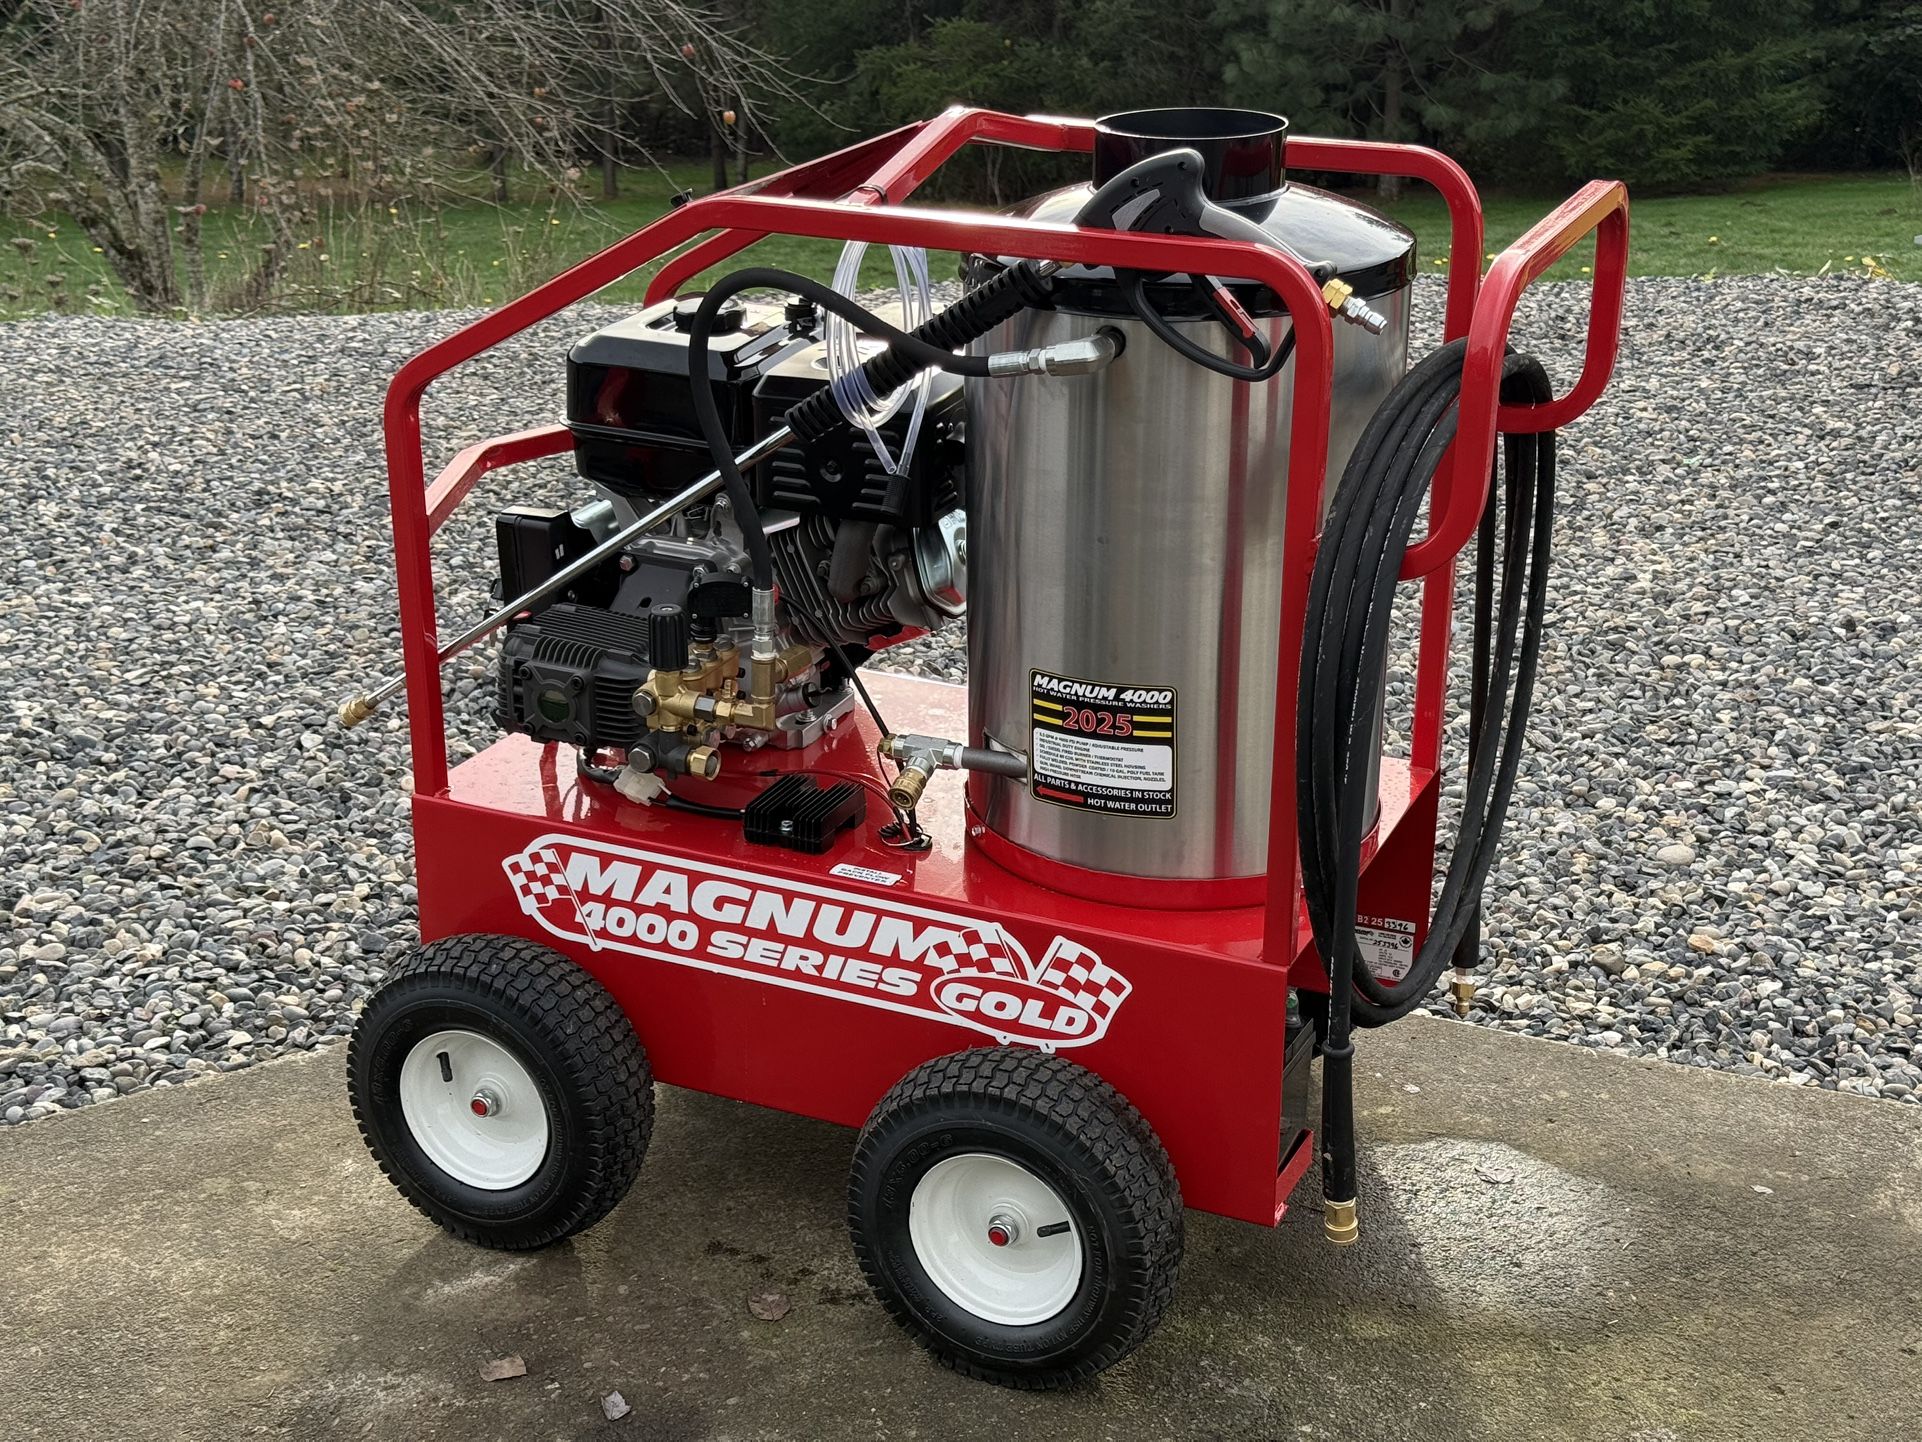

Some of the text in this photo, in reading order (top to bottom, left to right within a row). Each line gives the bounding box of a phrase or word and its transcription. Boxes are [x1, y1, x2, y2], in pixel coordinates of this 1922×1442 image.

[1033, 686, 1050, 694] HOT
[1050, 690, 1077, 700] WATER
[1079, 698, 1124, 707] PRESSURE
[1034, 674, 1172, 704] MAGNUM 4000
[1062, 706, 1132, 736] 2025
[1092, 743, 1120, 751] ADJUSTABLE
[1034, 773, 1046, 783] ALL
[1047, 777, 1069, 788] PARTS
[1078, 784, 1131, 798] ACCESSORIES
[1087, 798, 1172, 812] HOT WATER OUTLET
[562, 851, 955, 968] MAGNUM
[1357, 914, 1368, 924] B2
[1371, 917, 1383, 927] 25
[574, 901, 921, 997] 4000 SERIES
[943, 981, 1090, 1036] GOLD
